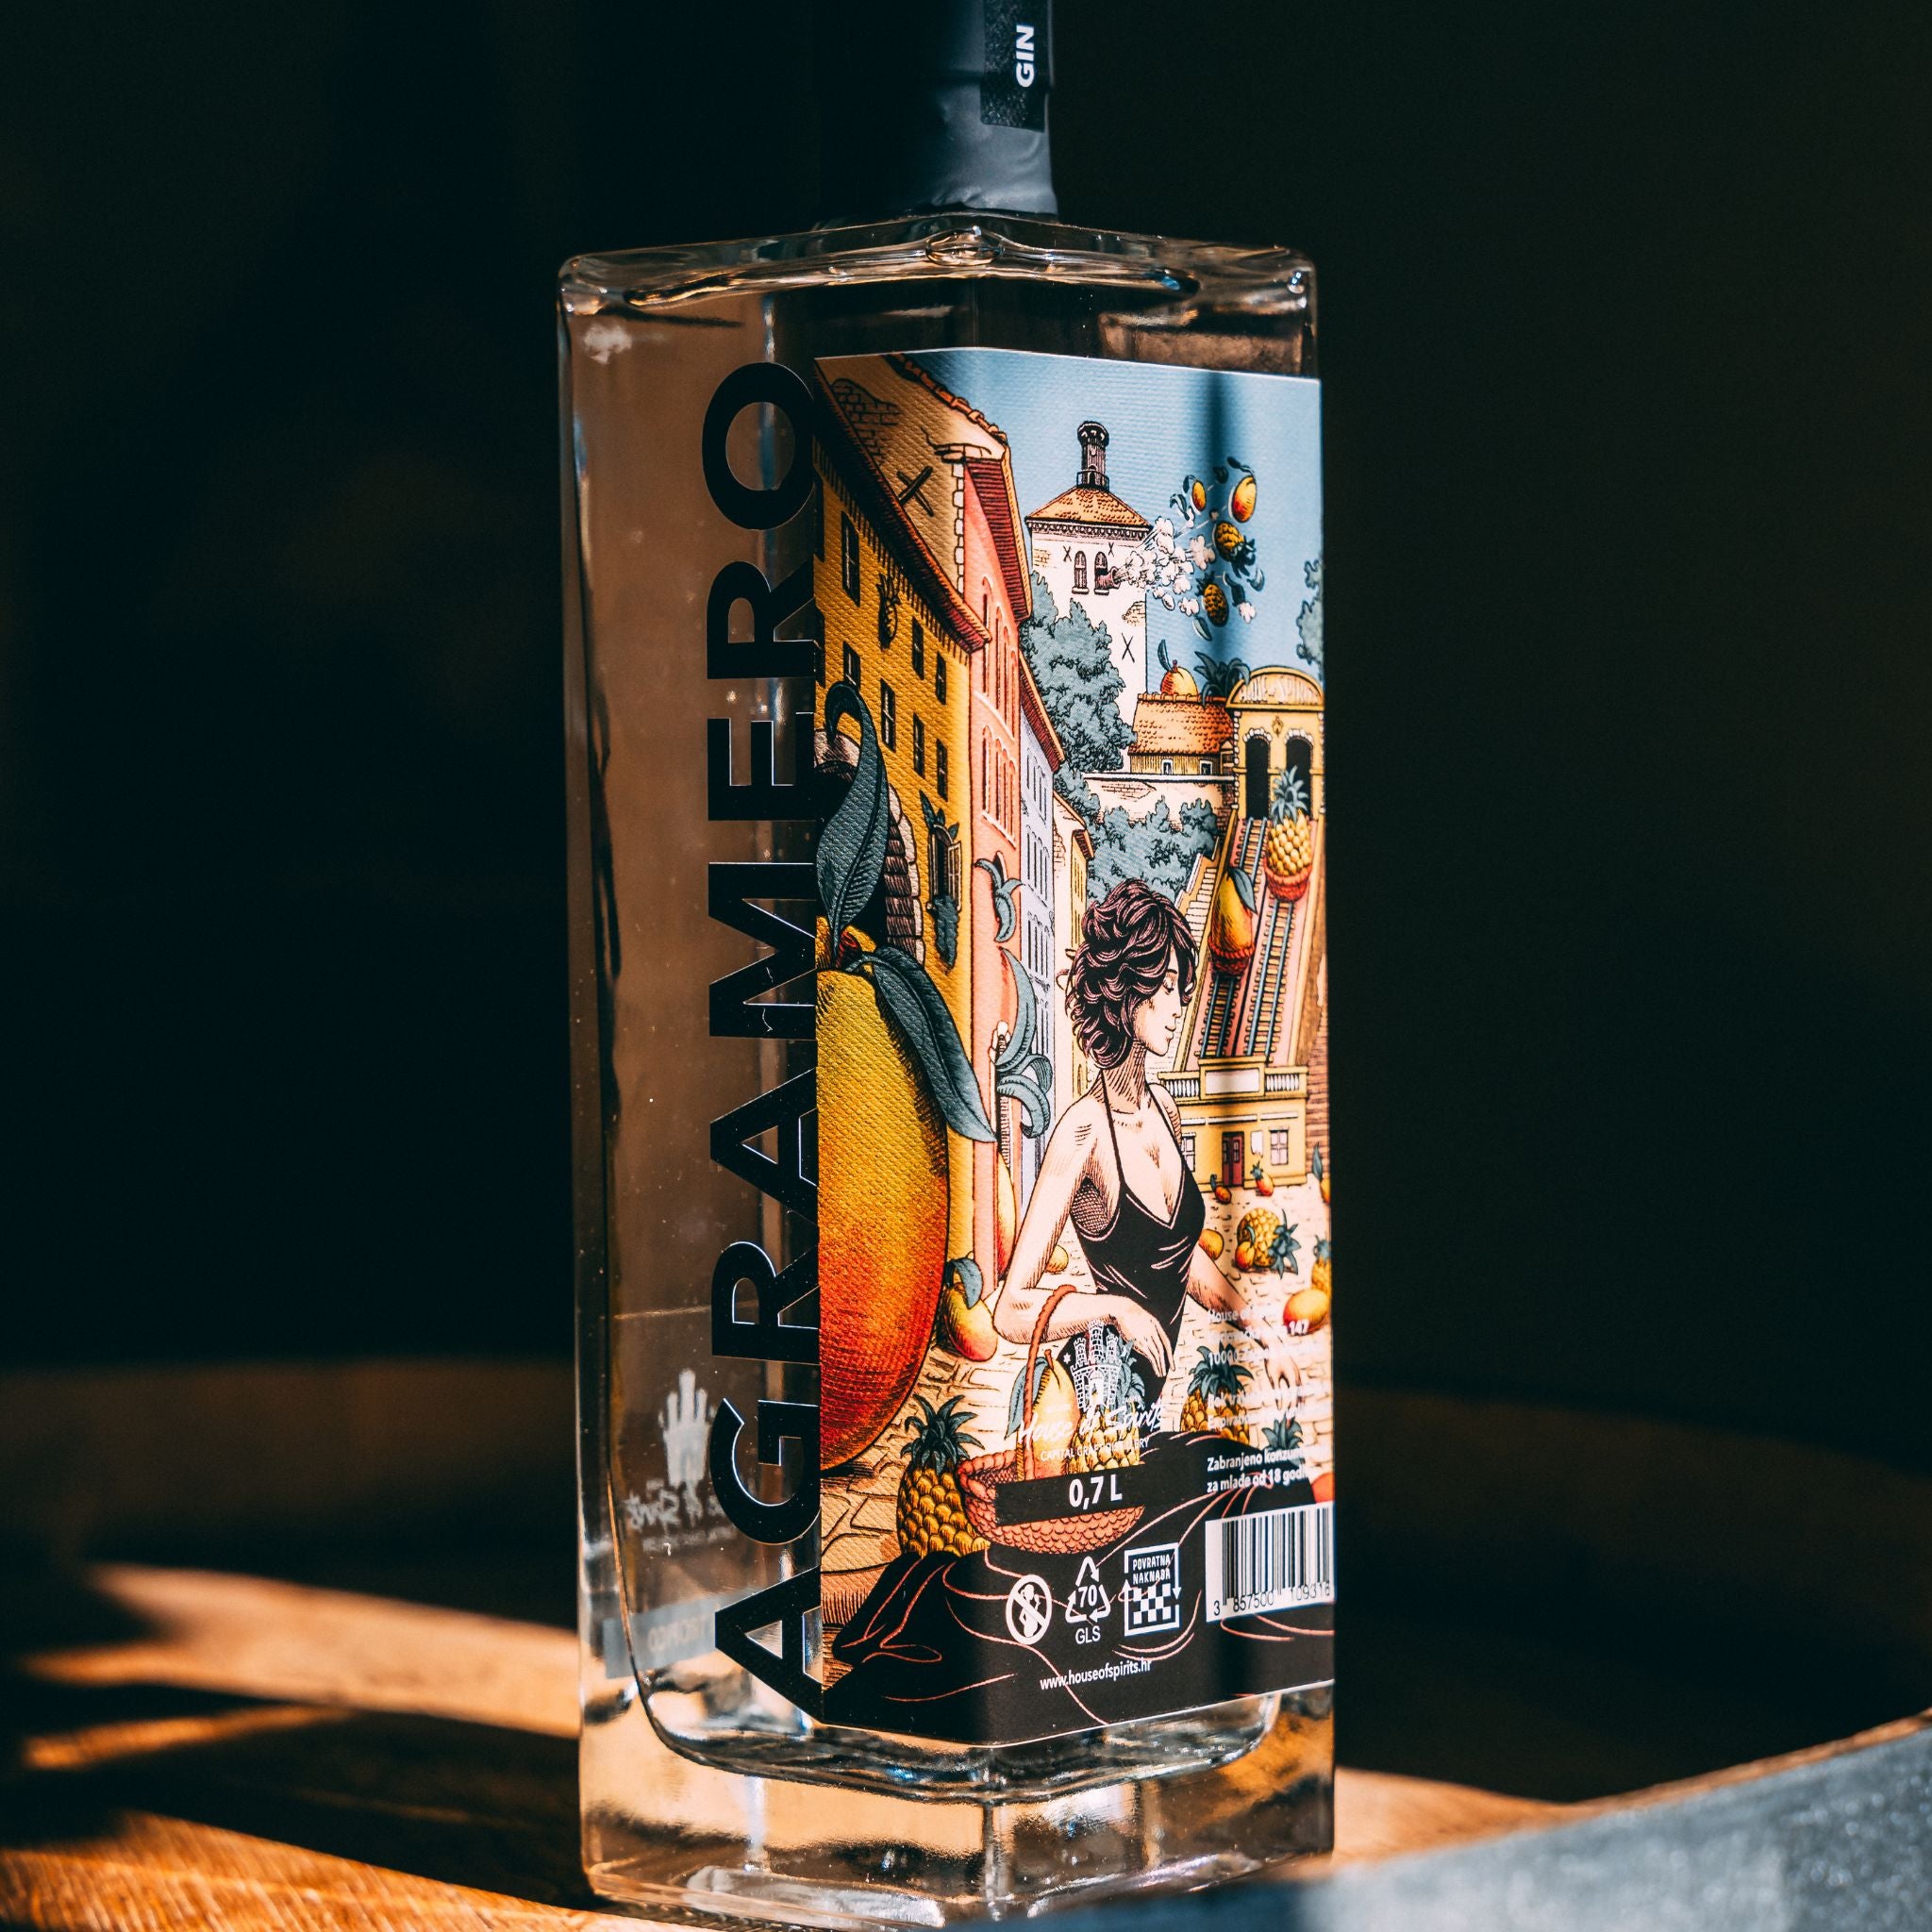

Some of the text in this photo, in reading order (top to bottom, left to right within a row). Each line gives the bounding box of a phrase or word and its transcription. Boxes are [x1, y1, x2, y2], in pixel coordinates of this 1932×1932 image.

[1016, 25, 1035, 88] GIN
[702, 361, 819, 1724] AGRAMERO
[1207, 1452, 1263, 1472] Zabranjeno
[1069, 1474, 1123, 1510] 0,7 L
[1207, 1480, 1219, 1493] za
[1252, 1469, 1267, 1488] od
[1268, 1468, 1282, 1485] 18
[1132, 1554, 1171, 1571] POVRATNA
[1132, 1568, 1171, 1586] NAKNADA
[1078, 1584, 1098, 1608] 70
[1213, 1599, 1222, 1616] 3
[1233, 1590, 1275, 1613] 857500
[1075, 1625, 1101, 1644] GLS
[1040, 1657, 1153, 1690] www.houseofspirits.hr
